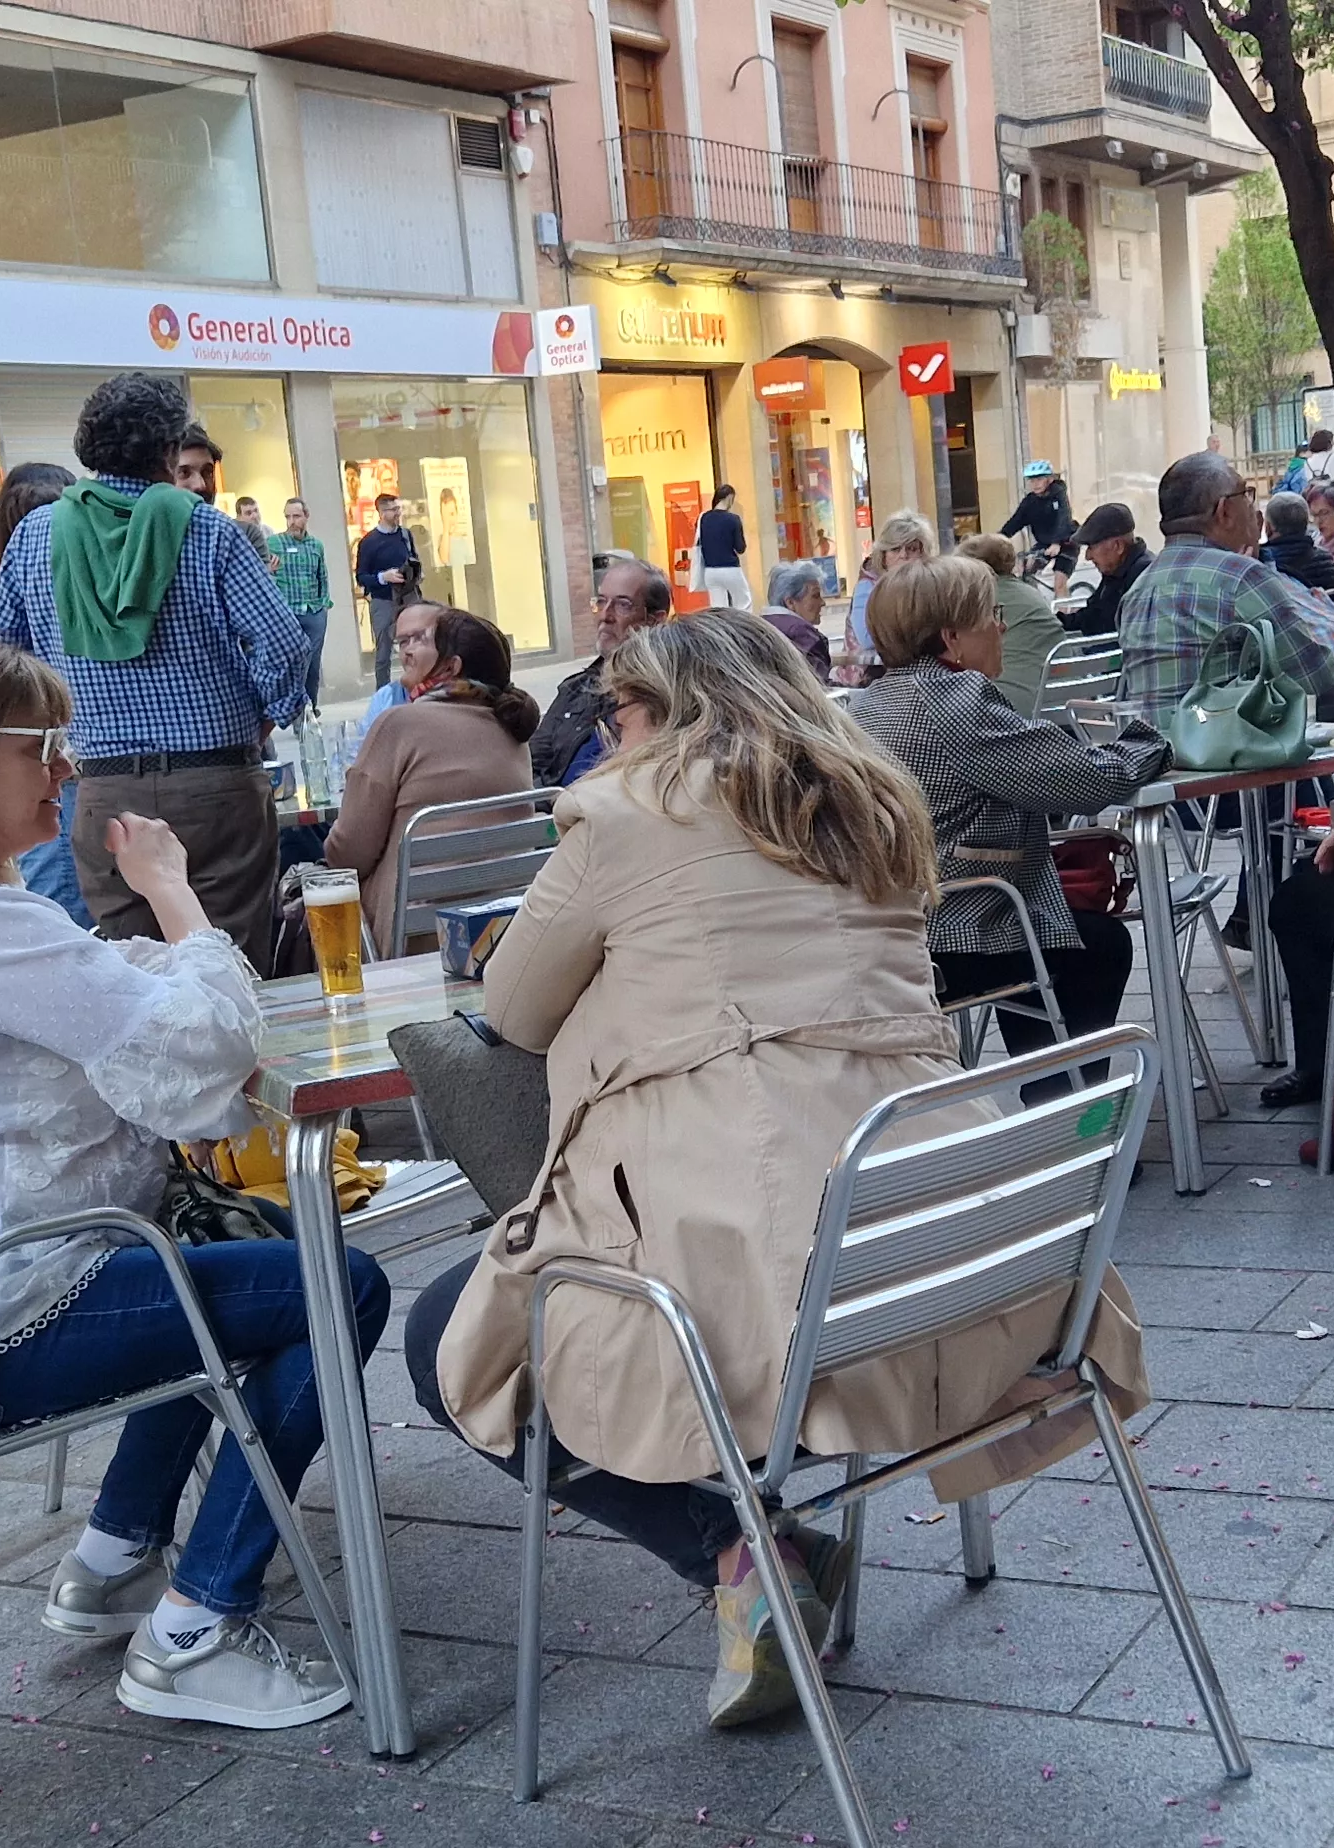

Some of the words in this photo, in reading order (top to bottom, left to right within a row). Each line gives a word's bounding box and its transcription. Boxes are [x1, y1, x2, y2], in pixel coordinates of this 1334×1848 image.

[187, 312, 278, 345] General
[283, 317, 351, 352] Optica
[192, 347, 222, 360] Visión
[232, 349, 272, 362] Audición
[547, 340, 587, 355] General
[551, 354, 584, 368] Optica
